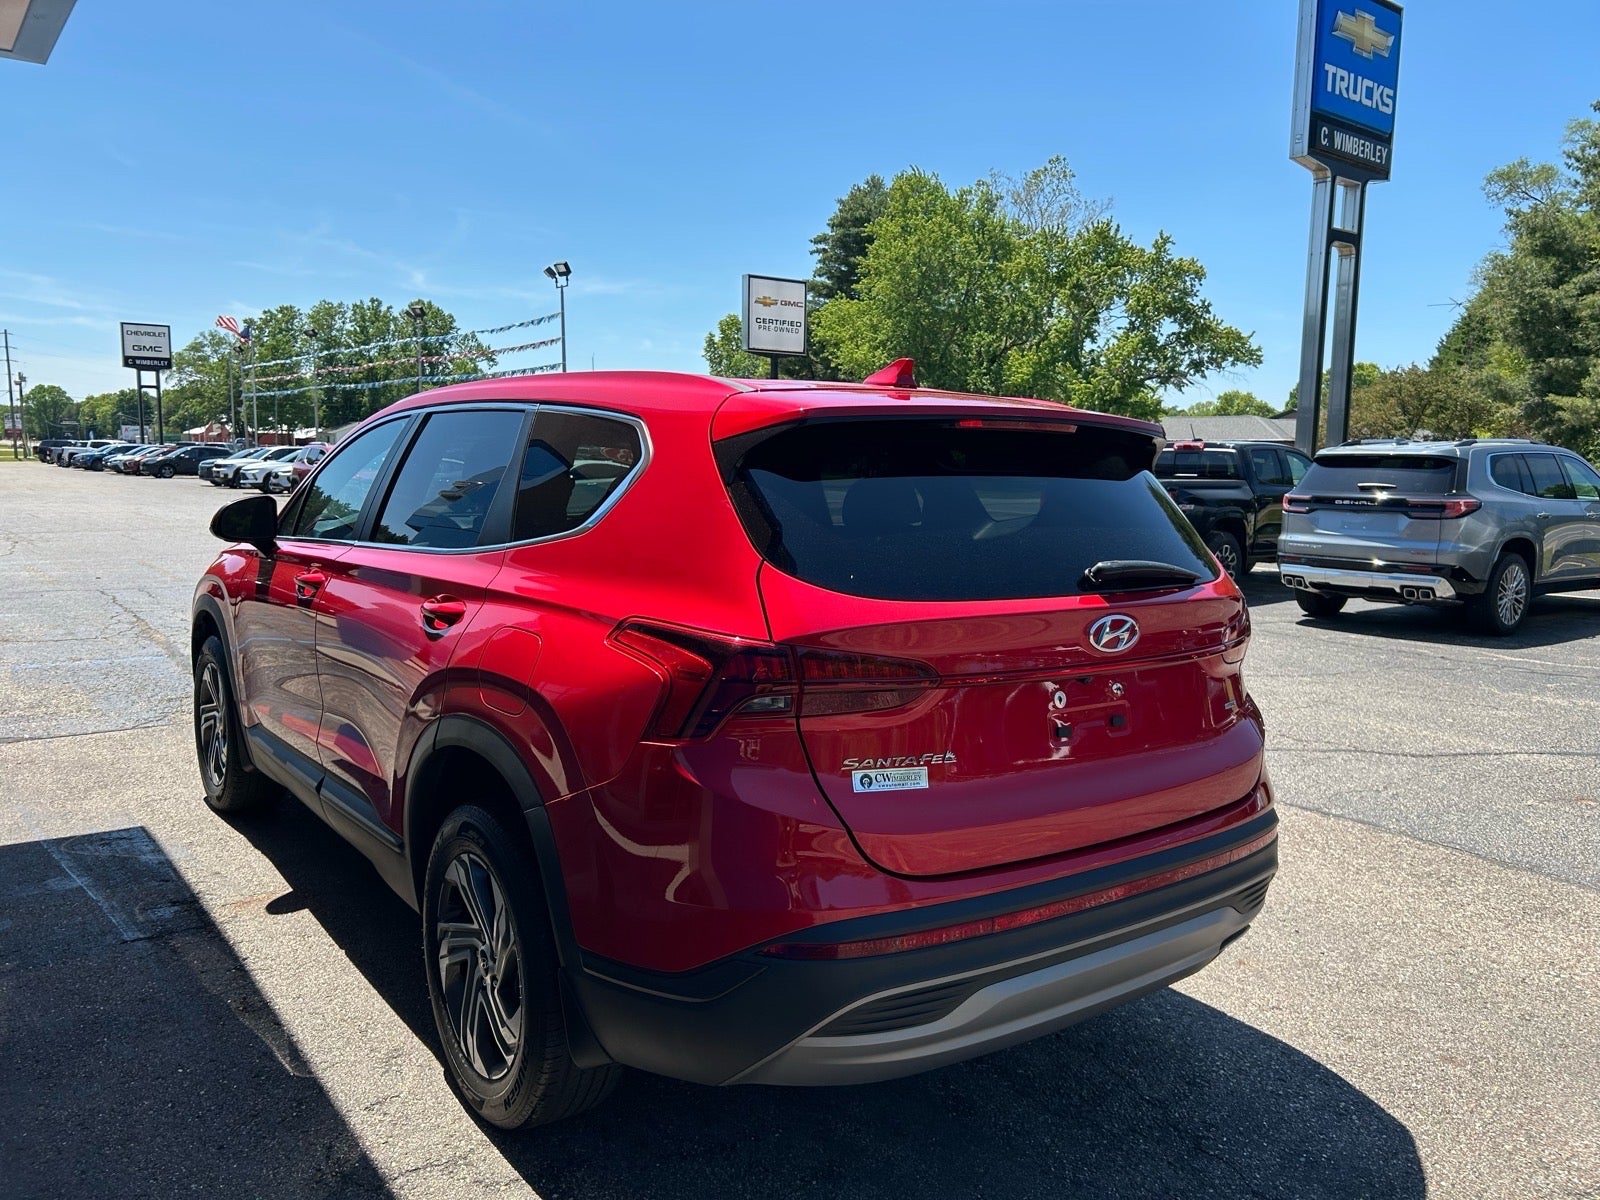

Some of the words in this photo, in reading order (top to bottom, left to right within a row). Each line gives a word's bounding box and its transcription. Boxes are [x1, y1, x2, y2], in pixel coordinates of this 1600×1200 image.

[1324, 62, 1394, 115] TRUCKS
[1320, 126, 1329, 146] C.
[1333, 129, 1388, 165] WIMBERLEY
[780, 300, 804, 308] GMC
[755, 317, 802, 328] CERTIFIED
[126, 330, 166, 338] CHEVROLET
[758, 325, 799, 334] PRE-OWNED
[132, 344, 163, 352] GMC
